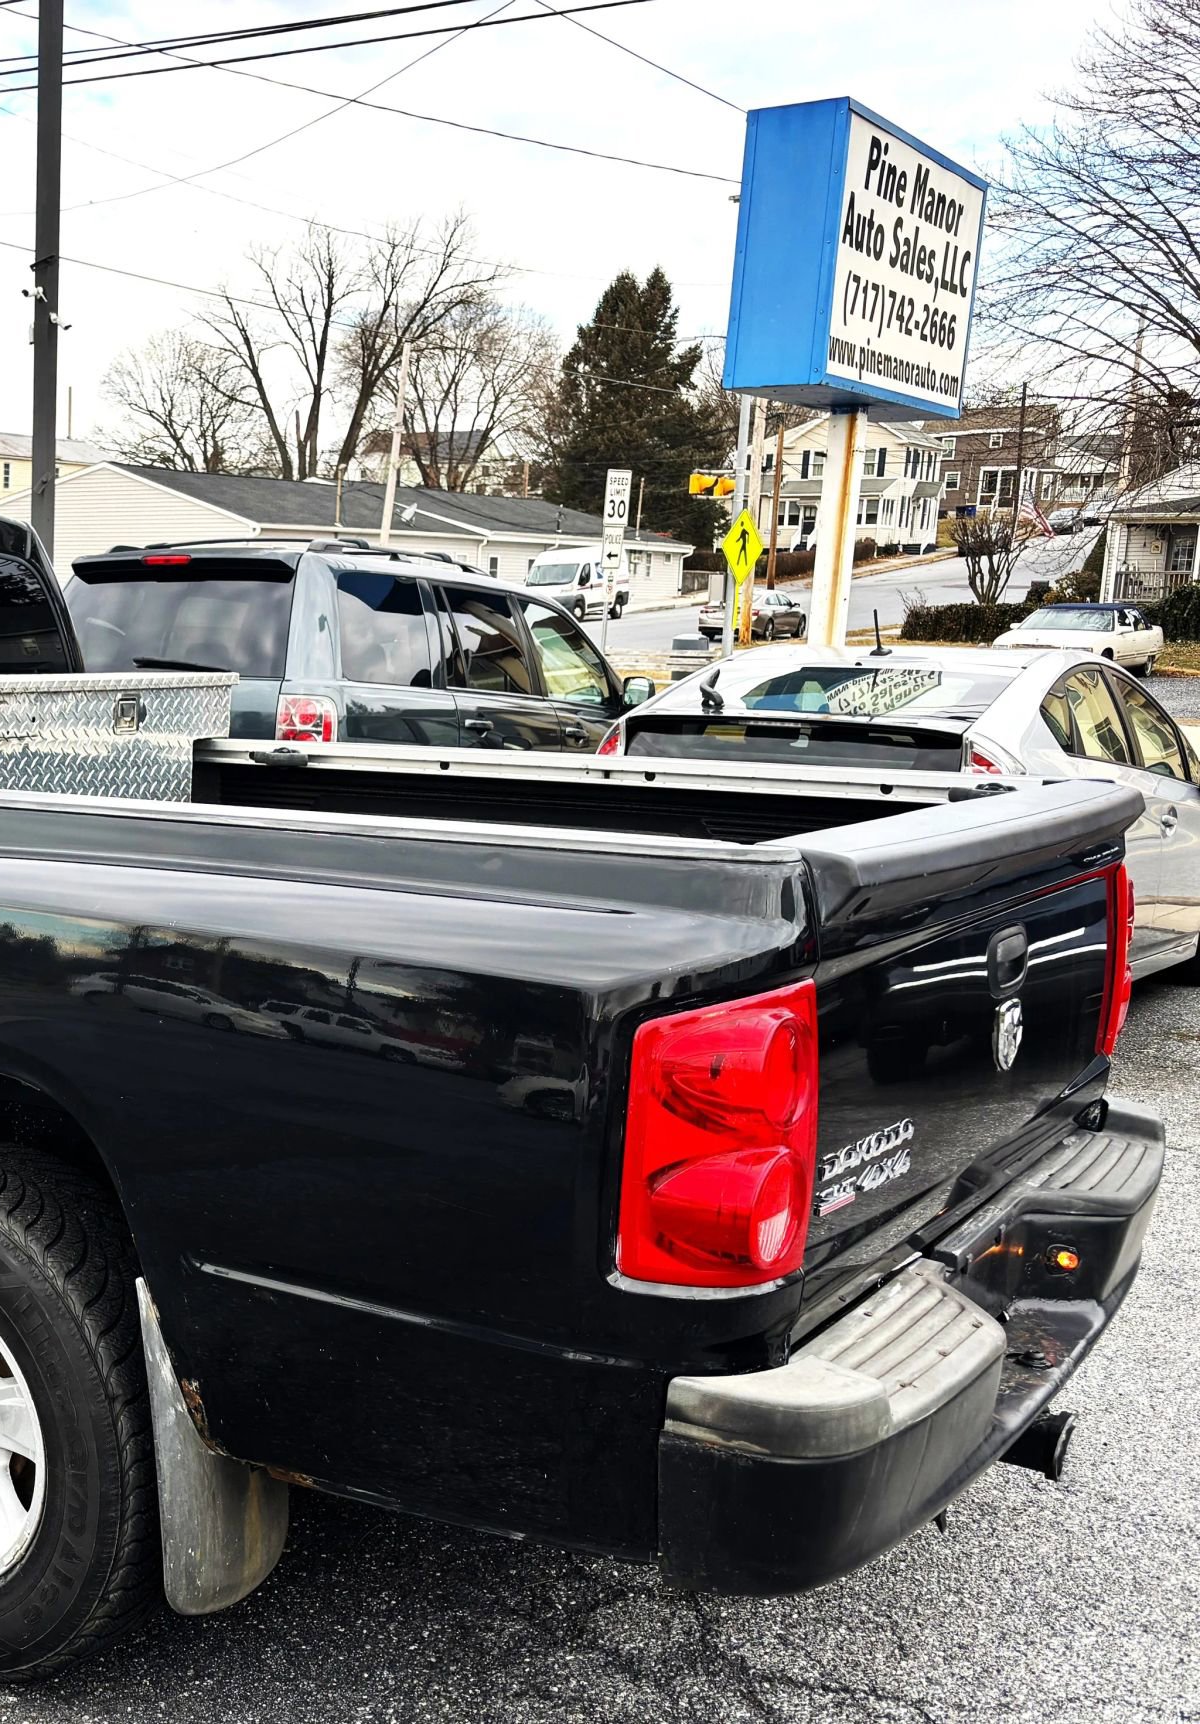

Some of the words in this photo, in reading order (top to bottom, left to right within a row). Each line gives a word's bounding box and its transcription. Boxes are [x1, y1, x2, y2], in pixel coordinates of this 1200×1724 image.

[864, 135, 907, 208] Pine
[910, 163, 964, 238] Manor
[842, 191, 885, 262] Auto
[843, 270, 957, 350] (717)742-2666
[828, 335, 959, 398] www.pinemanorauto.com
[607, 499, 626, 518] 30
[609, 477, 629, 486] SPEED
[609, 488, 626, 496] LIMIT
[605, 534, 622, 544] POLICE
[818, 1118, 914, 1182] DAKOTA
